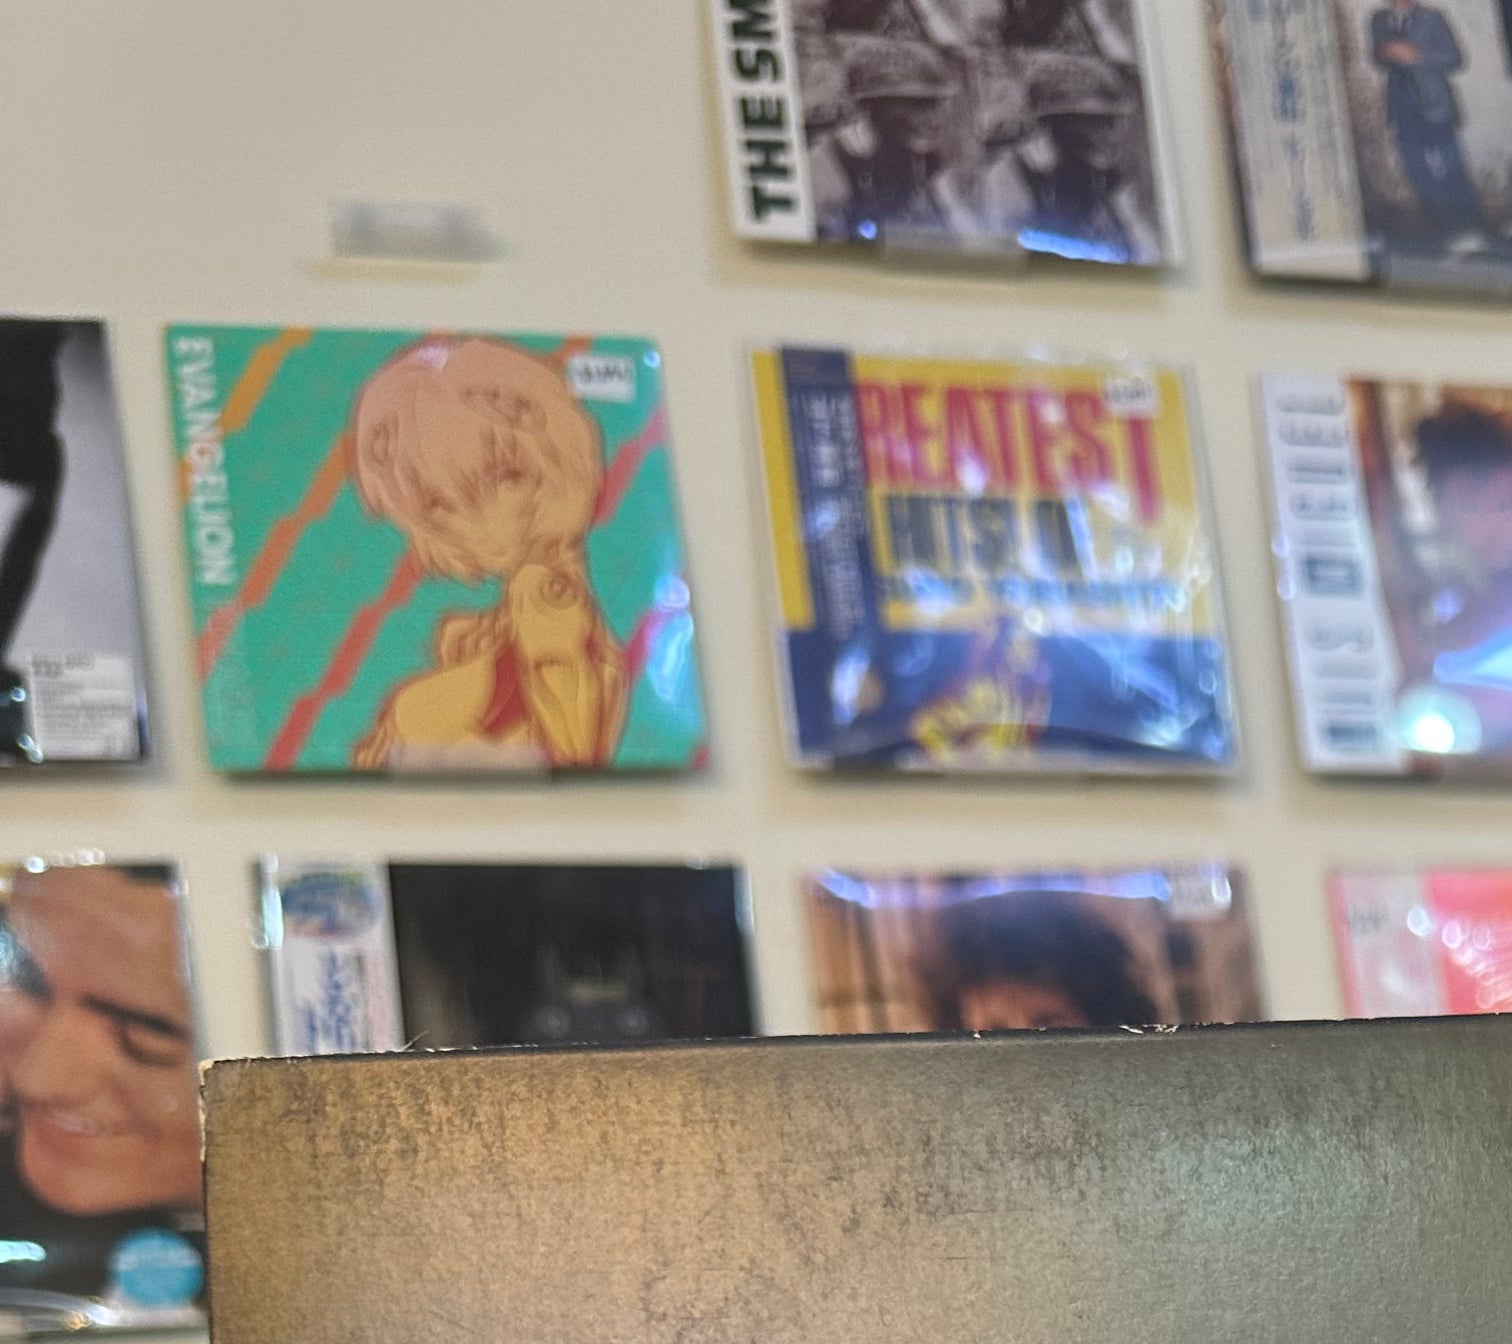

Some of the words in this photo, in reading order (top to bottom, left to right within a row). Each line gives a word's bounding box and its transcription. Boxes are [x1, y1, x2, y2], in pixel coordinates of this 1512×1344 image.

[727, 0, 781, 81] SM
[739, 96, 795, 221] THE
[173, 335, 238, 586] EVANGELION
[855, 381, 1163, 527] REATEST
